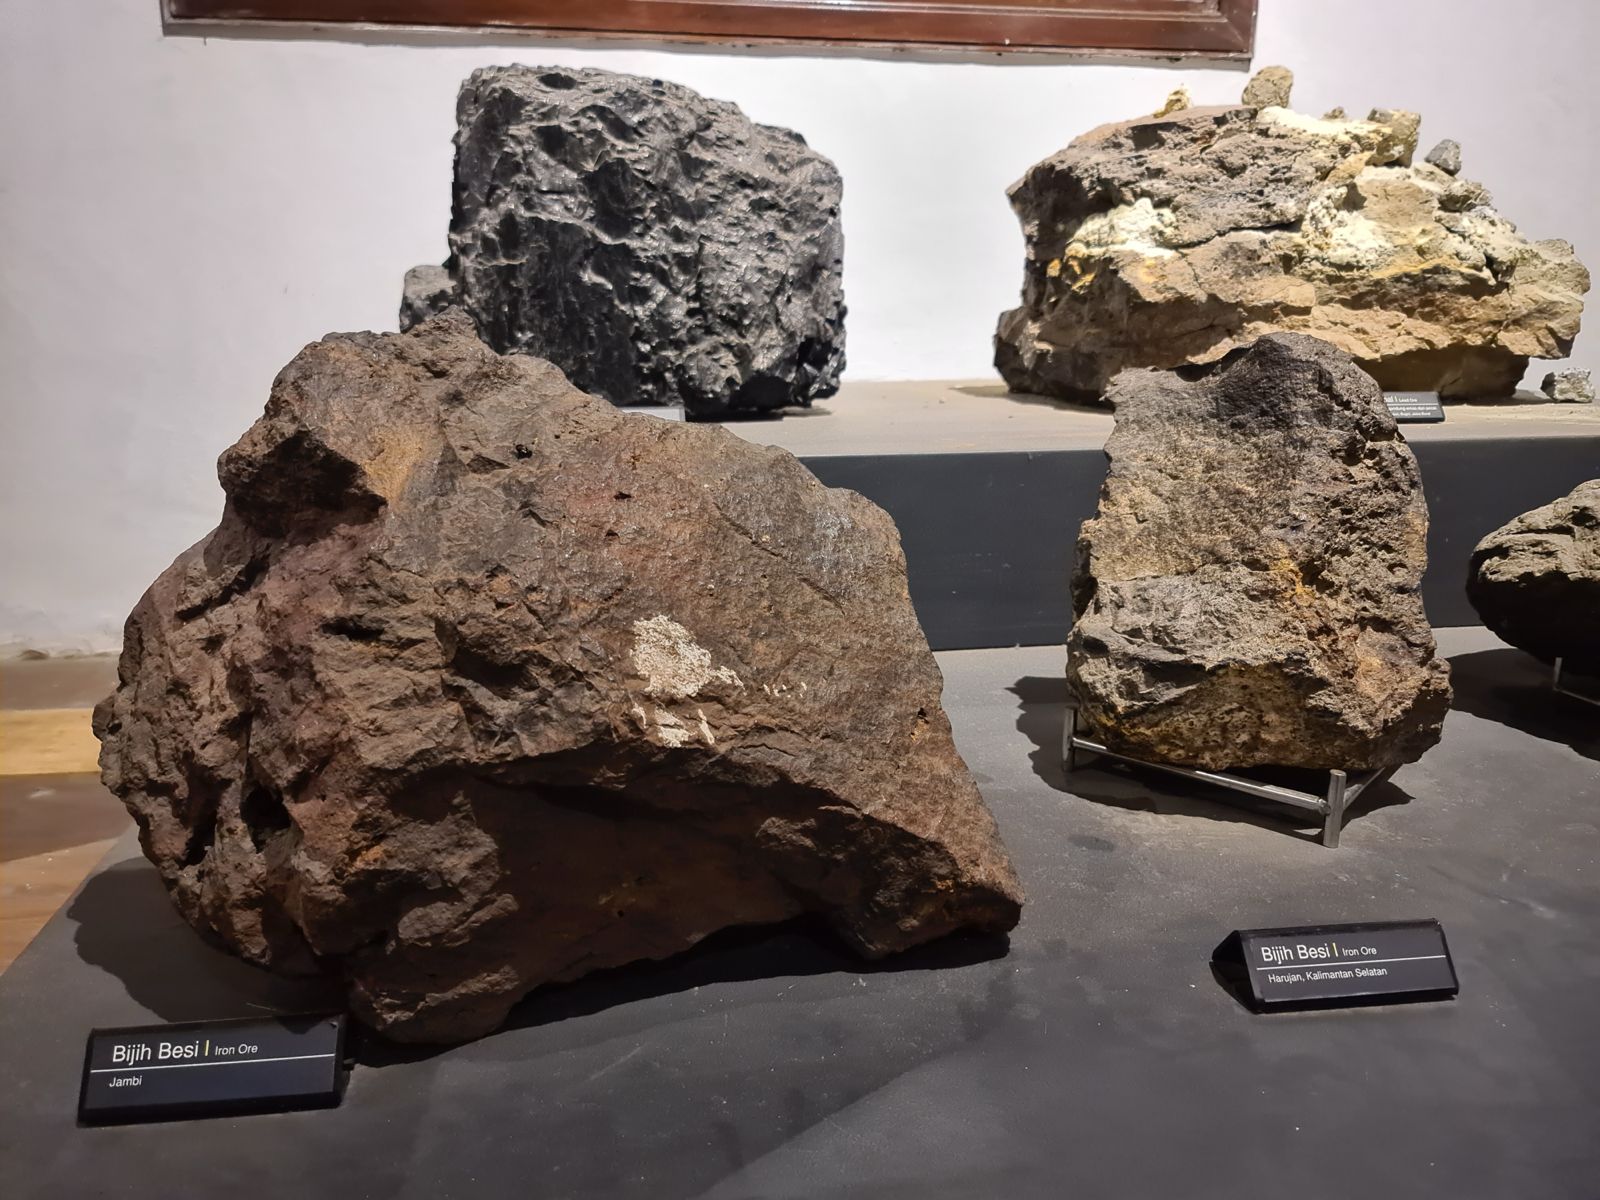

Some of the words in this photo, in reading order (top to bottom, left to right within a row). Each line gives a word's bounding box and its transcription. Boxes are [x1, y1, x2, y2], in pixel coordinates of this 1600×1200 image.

[1261, 944, 1294, 965] Bijih
[1297, 943, 1331, 960] Besi
[1342, 947, 1359, 957] Iron
[1361, 946, 1377, 956] Ore
[1268, 971, 1305, 984] Harujan,
[1306, 969, 1354, 981] Kalimantan
[1355, 966, 1388, 978] Selatan
[112, 1044, 151, 1065] Bijih
[158, 1041, 199, 1060] Besi
[214, 1044, 235, 1056] Iron
[238, 1043, 258, 1055] Ore
[109, 1075, 142, 1088] Jambi
